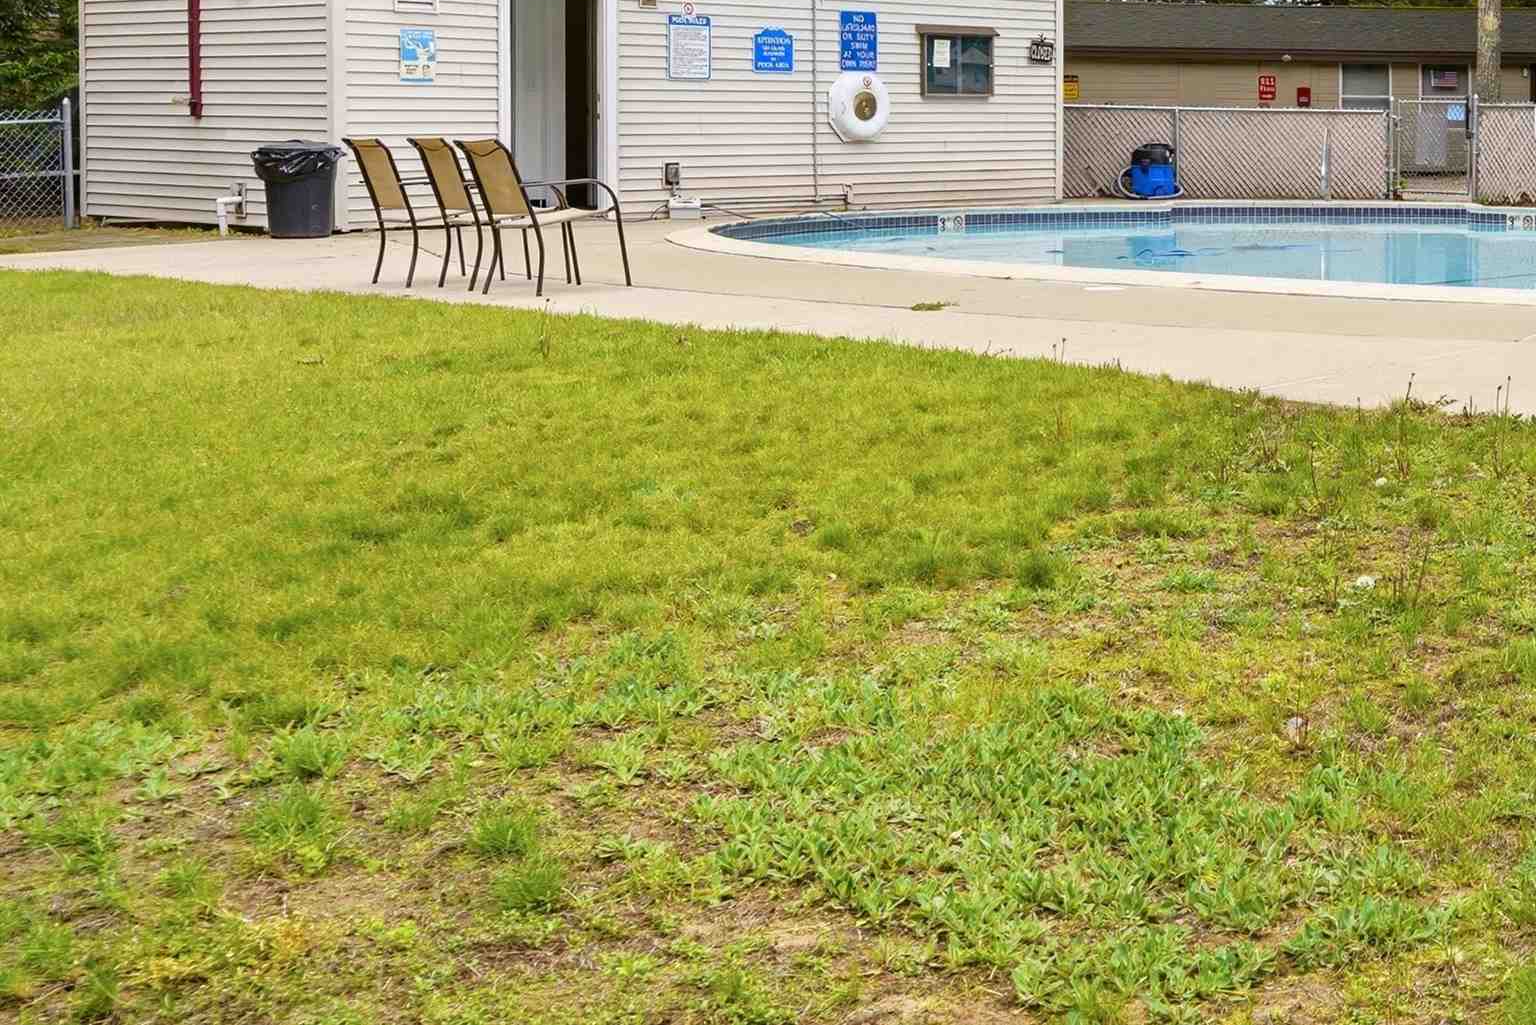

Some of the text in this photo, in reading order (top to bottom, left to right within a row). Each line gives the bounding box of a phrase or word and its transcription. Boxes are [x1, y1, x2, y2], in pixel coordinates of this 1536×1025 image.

[853, 15, 865, 24] NO
[842, 32, 875, 41] ON DUTY
[850, 41, 869, 50] SWIM
[1031, 45, 1053, 61] CLOSED
